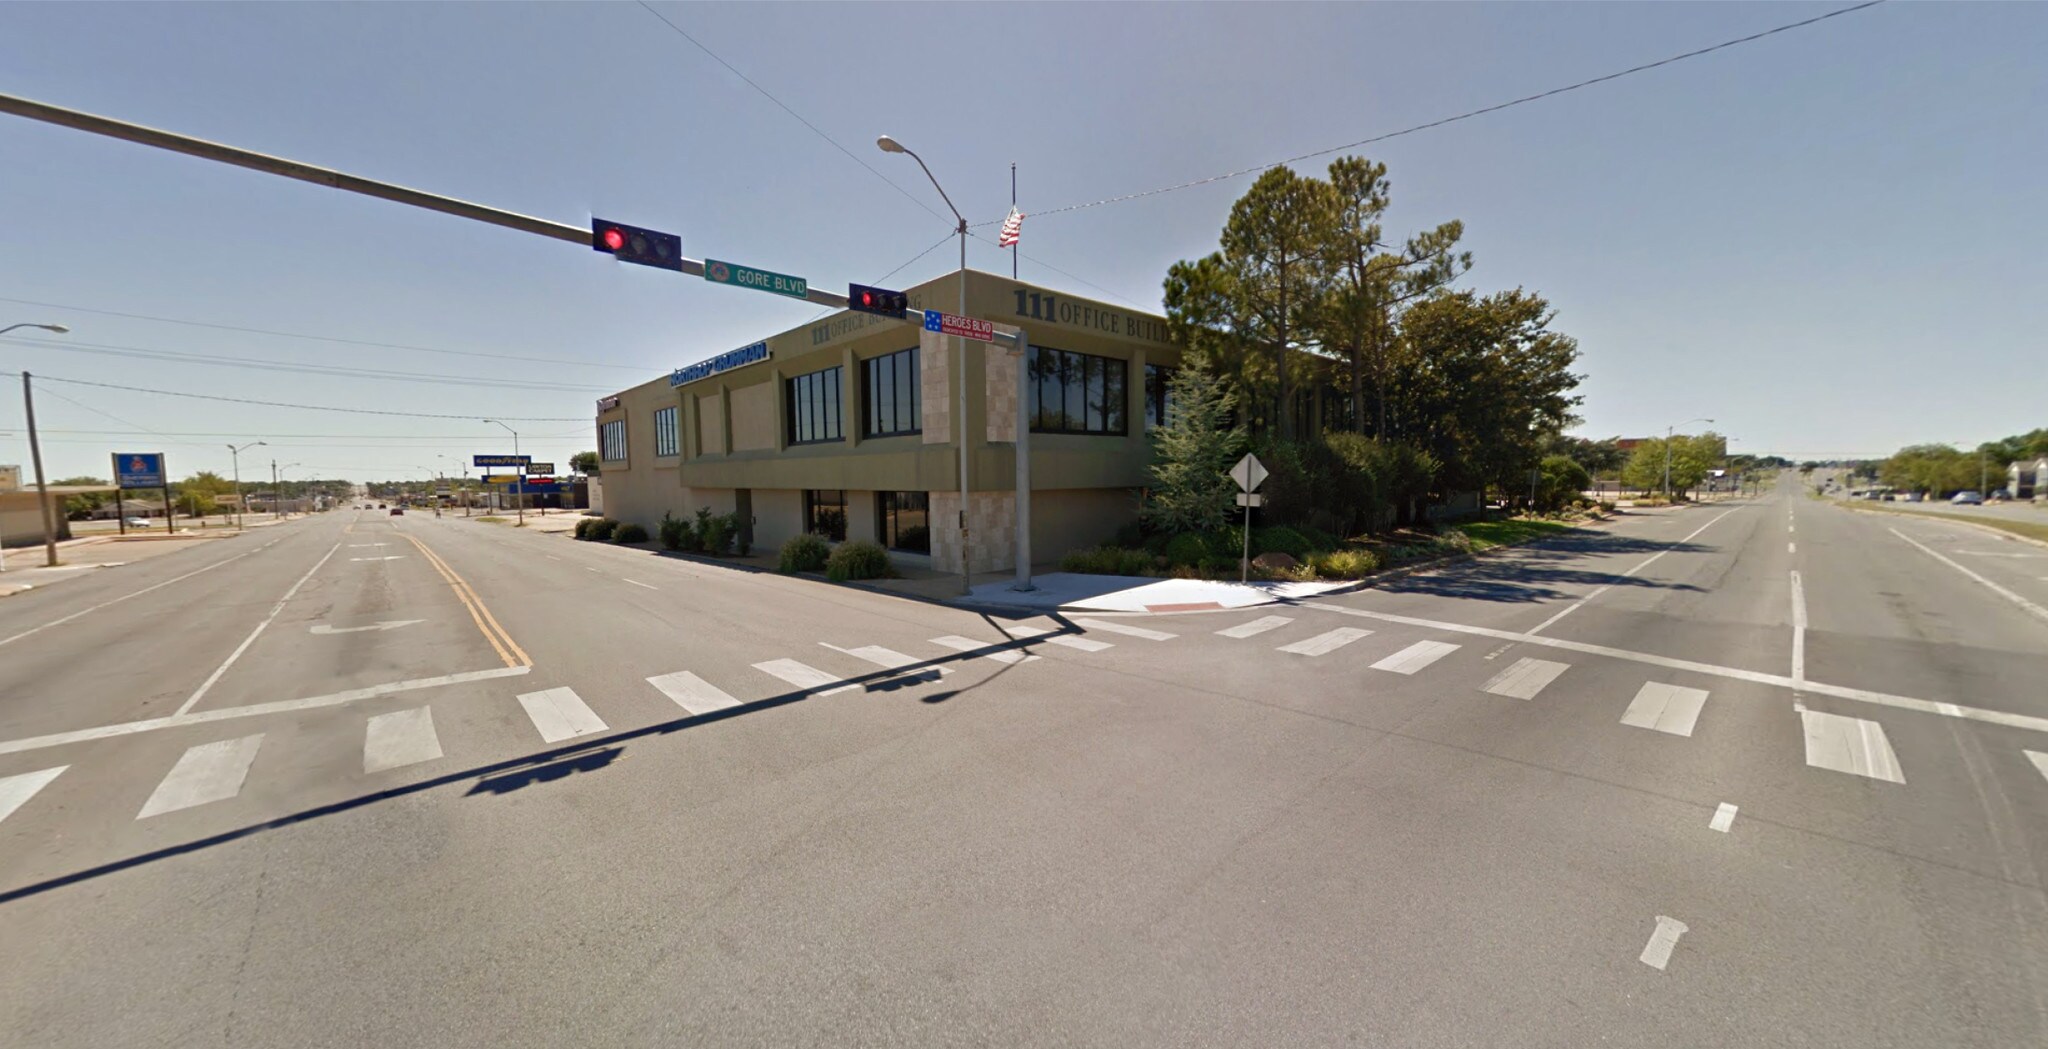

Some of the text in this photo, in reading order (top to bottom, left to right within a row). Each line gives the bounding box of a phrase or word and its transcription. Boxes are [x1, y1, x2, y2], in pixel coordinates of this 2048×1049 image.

[737, 269, 805, 294] GORE BLVD
[831, 313, 865, 337] OFFICE
[942, 313, 992, 333] HEROES BLVD
[1014, 289, 1170, 343] 111 OFFICE BUILD
[714, 341, 767, 372] GRUMMAN
